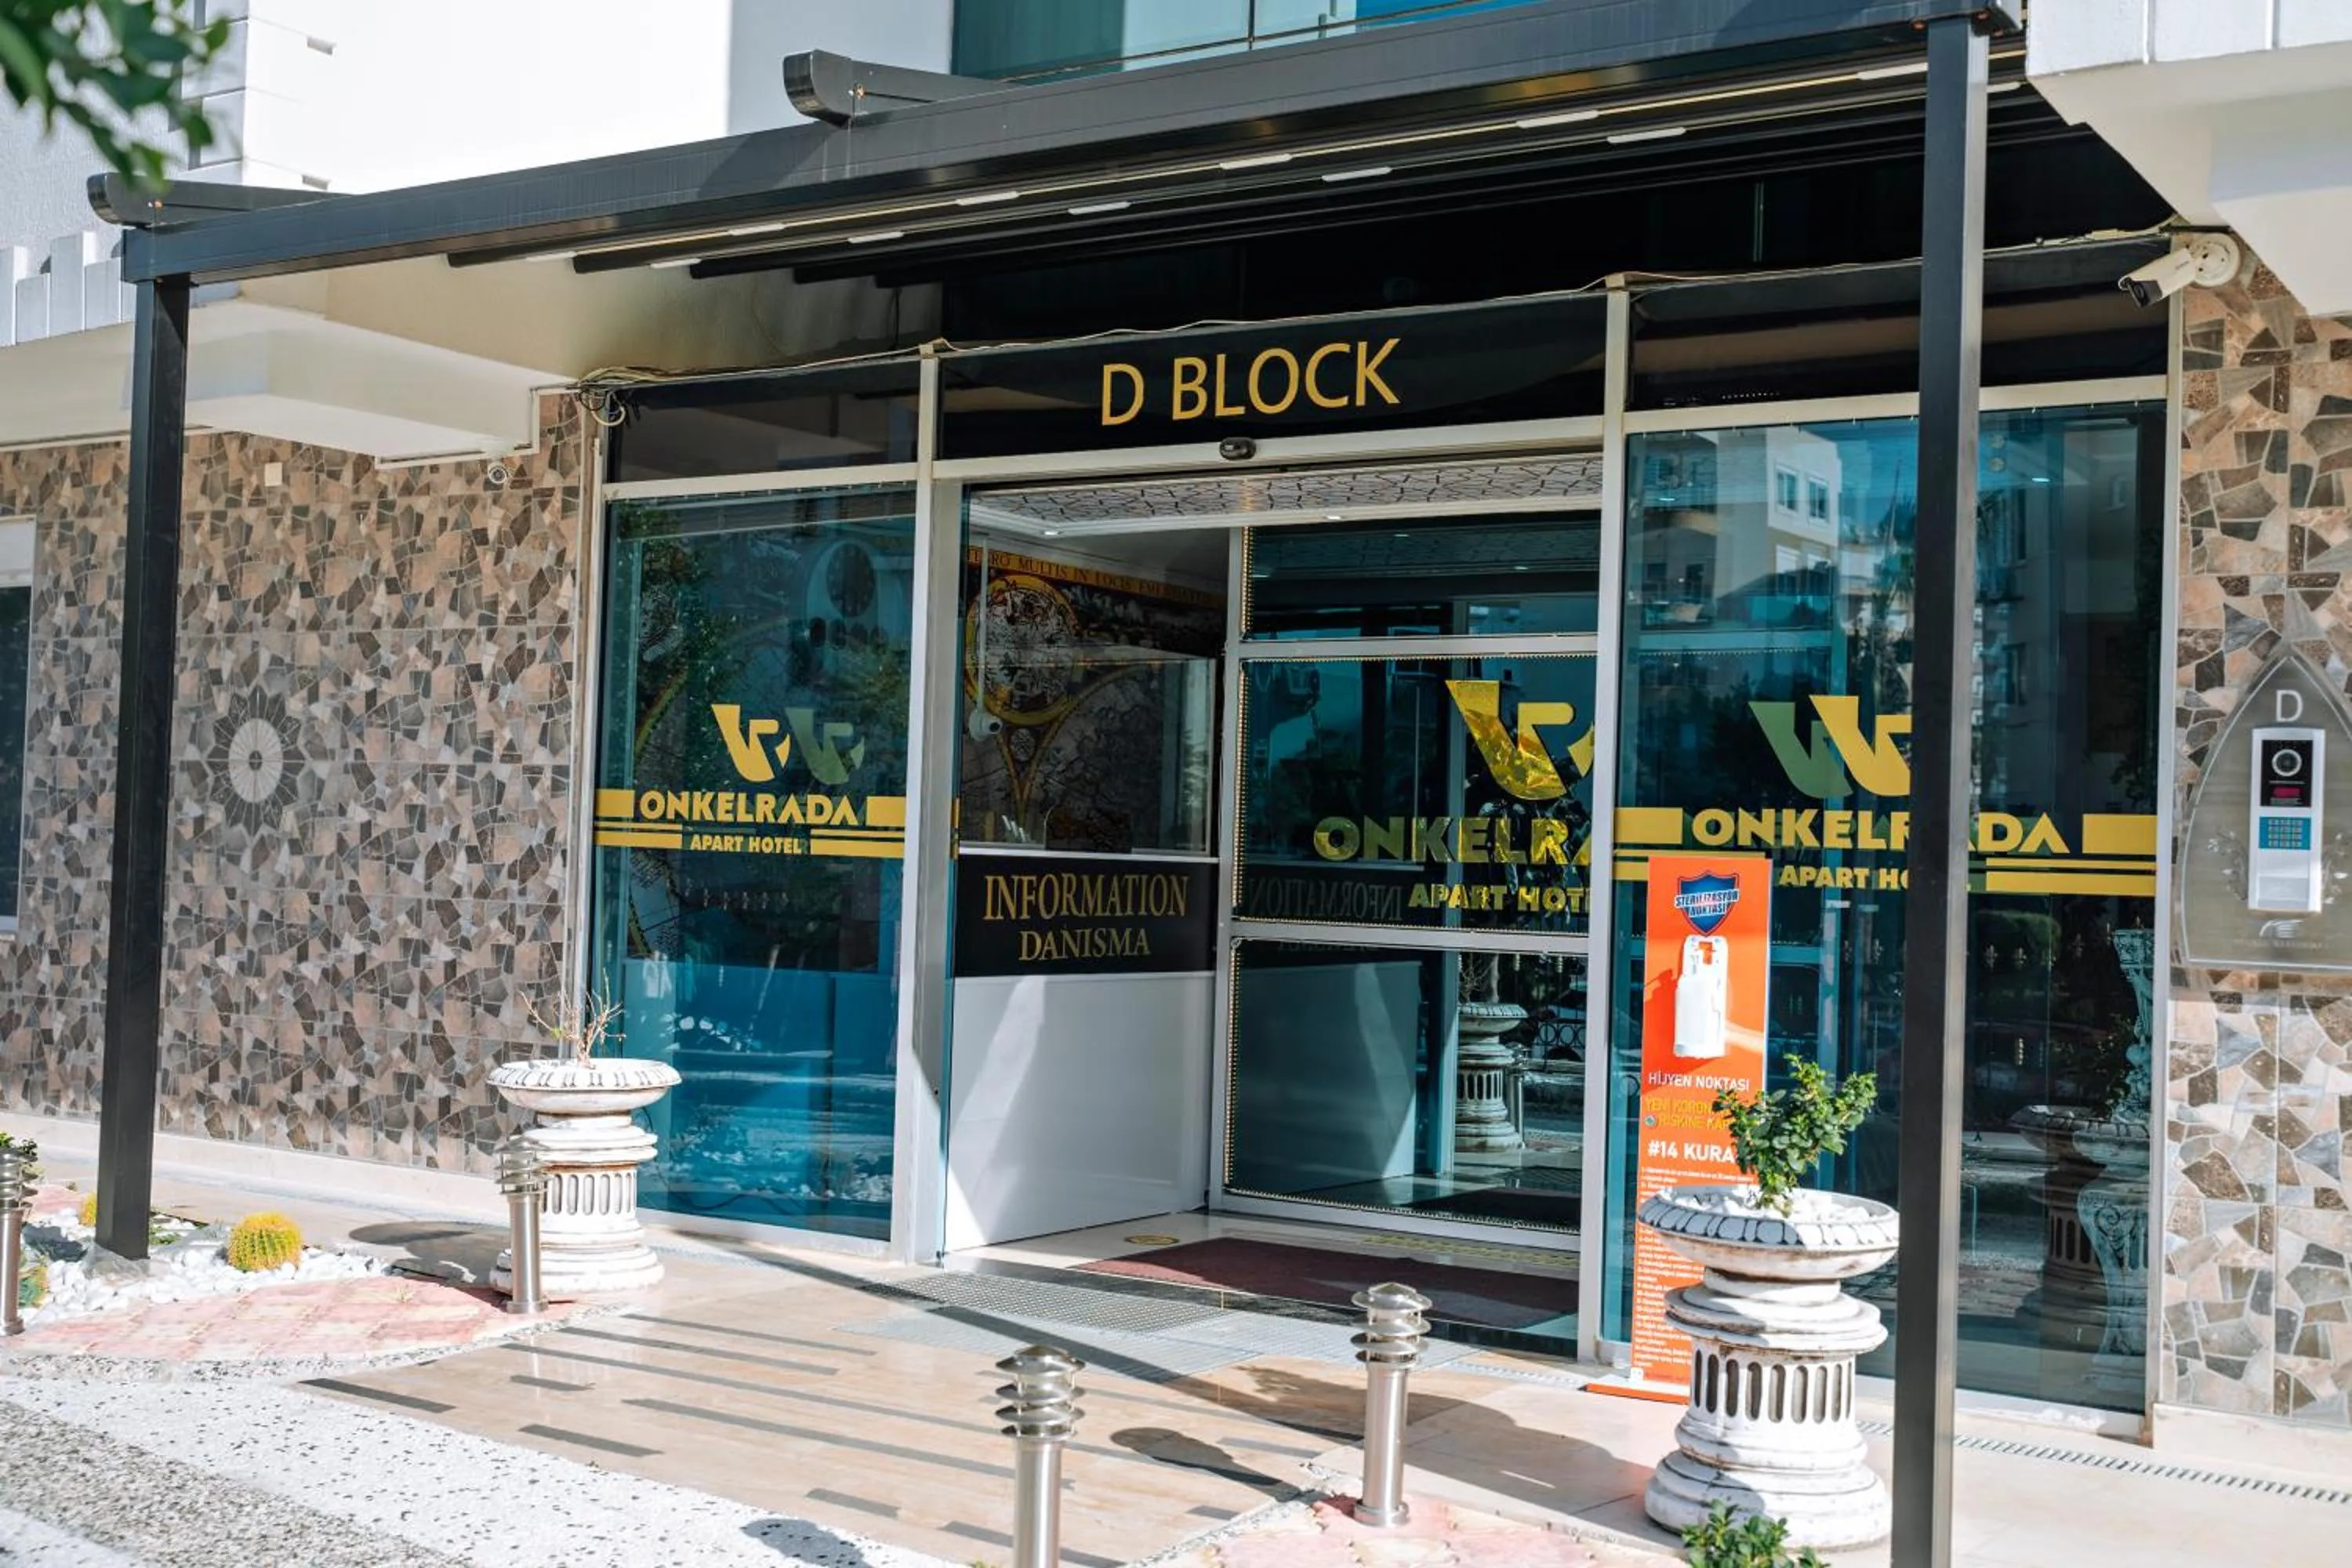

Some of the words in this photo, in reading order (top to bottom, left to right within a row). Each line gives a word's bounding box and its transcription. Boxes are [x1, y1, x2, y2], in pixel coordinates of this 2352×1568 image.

[1102, 363, 1145, 426] D
[1171, 338, 1401, 421] BLOCK
[2275, 689, 2303, 723] D
[639, 790, 858, 826] ONKELRADA
[690, 834, 743, 852] APART
[748, 836, 802, 855] HOTEL
[1779, 865, 1870, 889] APART
[982, 873, 1190, 921] INFORMATION
[1408, 883, 1508, 911] APART
[1019, 927, 1152, 961] DANISMA
[1696, 1075, 1750, 1092] NOKTASI
[1648, 1138, 1679, 1159] #14
